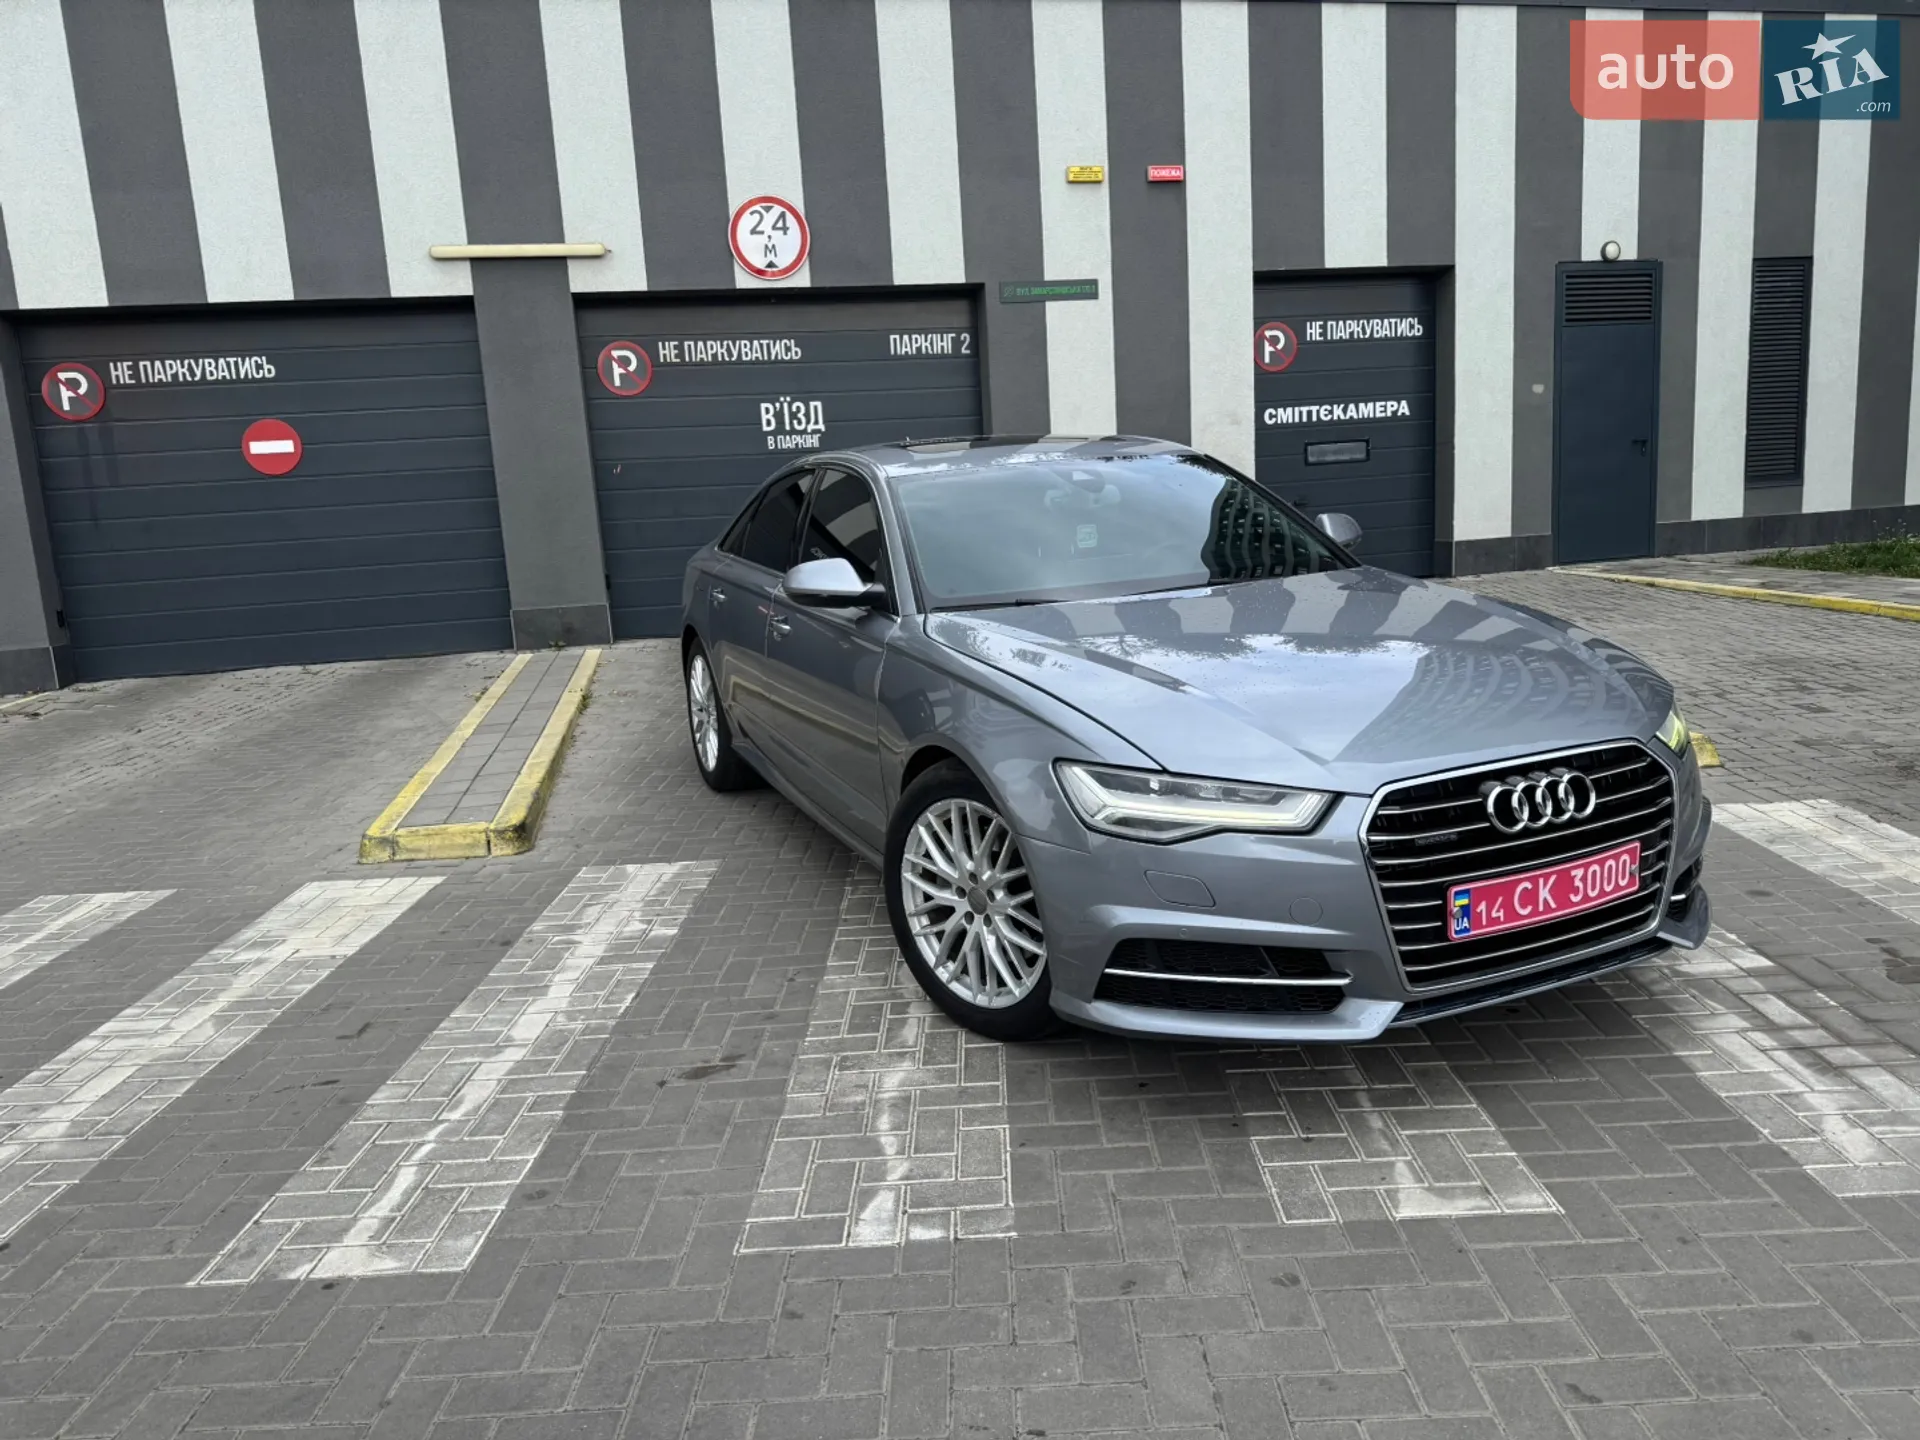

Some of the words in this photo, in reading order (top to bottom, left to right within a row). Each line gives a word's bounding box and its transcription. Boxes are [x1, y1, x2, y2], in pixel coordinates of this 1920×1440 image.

[1306, 320, 1324, 341] НЕ
[1327, 317, 1423, 340] ПАРКУВАТИСЬ
[658, 341, 682, 363] НЕ
[684, 339, 802, 362] ПАРКУВАТИСЬ
[889, 333, 956, 356] ПАРКІНГ
[960, 333, 971, 355] 2
[109, 361, 135, 385] НЕ
[139, 356, 276, 384] ПАРКУВАТИСЬ
[1264, 400, 1411, 425] СМІТТЄКАМЕРА
[767, 436, 776, 450] В
[777, 434, 822, 449] ПАРКІНГ
[1476, 896, 1505, 926] 14
[1513, 874, 1558, 917] CK
[1569, 853, 1630, 903] 3000
[1454, 915, 1470, 931] UA
